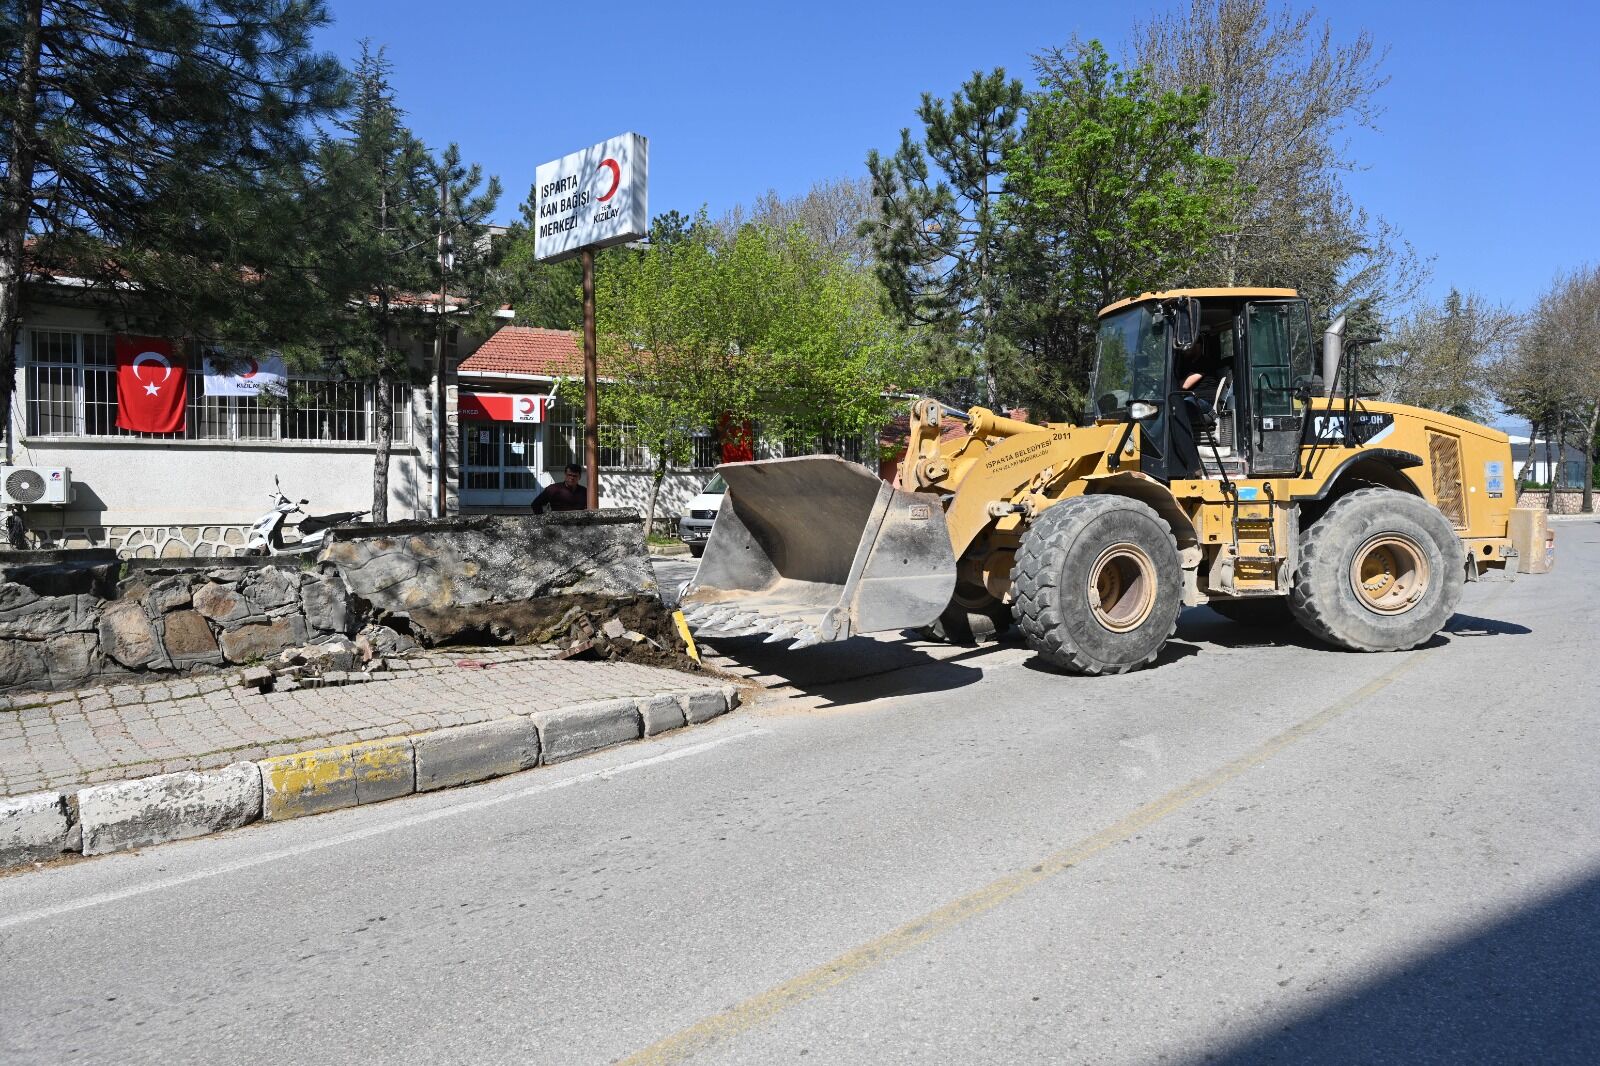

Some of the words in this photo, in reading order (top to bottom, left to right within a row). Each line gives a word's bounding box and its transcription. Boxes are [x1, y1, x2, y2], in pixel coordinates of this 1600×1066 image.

[541, 174, 578, 199] ISPARTA
[540, 200, 558, 219] KAN
[560, 190, 590, 213] BAĞIŞI
[540, 212, 578, 239] MERKEZİ
[593, 207, 620, 225] KIZILAY
[1053, 432, 1071, 441] 2011
[1014, 439, 1052, 459] BELEDİYESİ
